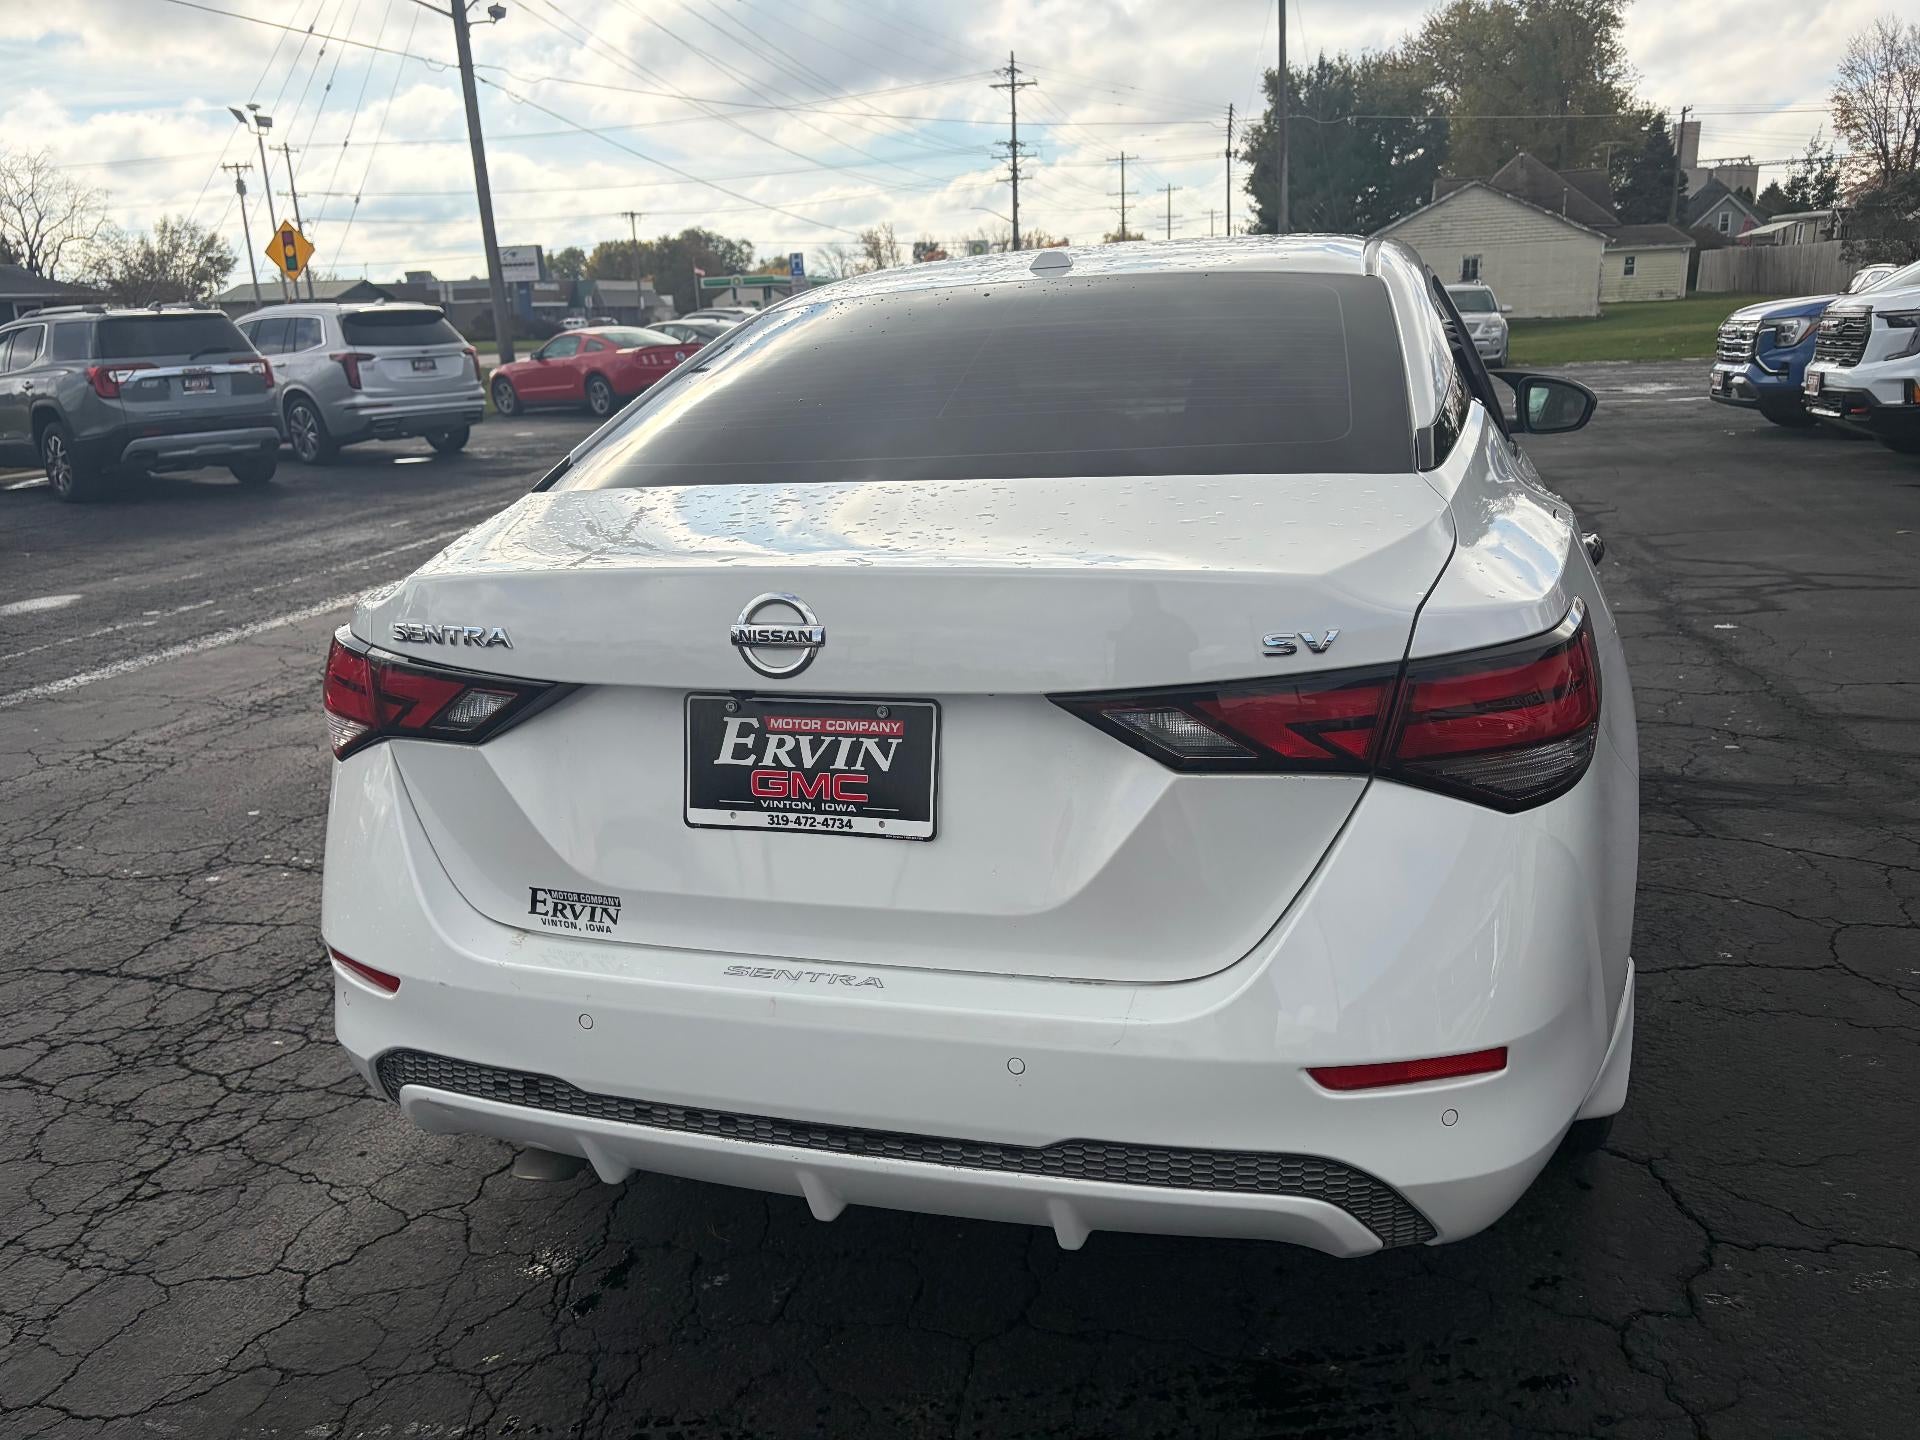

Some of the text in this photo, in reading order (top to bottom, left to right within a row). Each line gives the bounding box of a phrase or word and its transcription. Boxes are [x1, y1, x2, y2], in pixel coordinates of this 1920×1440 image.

[392, 623, 514, 649] SENTRA
[738, 629, 813, 643] NISSAN
[1263, 629, 1340, 656] SV
[770, 718, 901, 733] MOTOR COMPANY
[713, 716, 902, 772] ERVIN
[751, 769, 869, 802] GMC
[760, 800, 857, 813] VINTON, IOWA
[767, 814, 853, 830] 319-472-4734
[528, 886, 621, 926] ERVIN
[551, 890, 620, 907] MOTOR COMPANY
[541, 917, 612, 934] VINTON, IOWA
[723, 965, 884, 989] SENTRA
